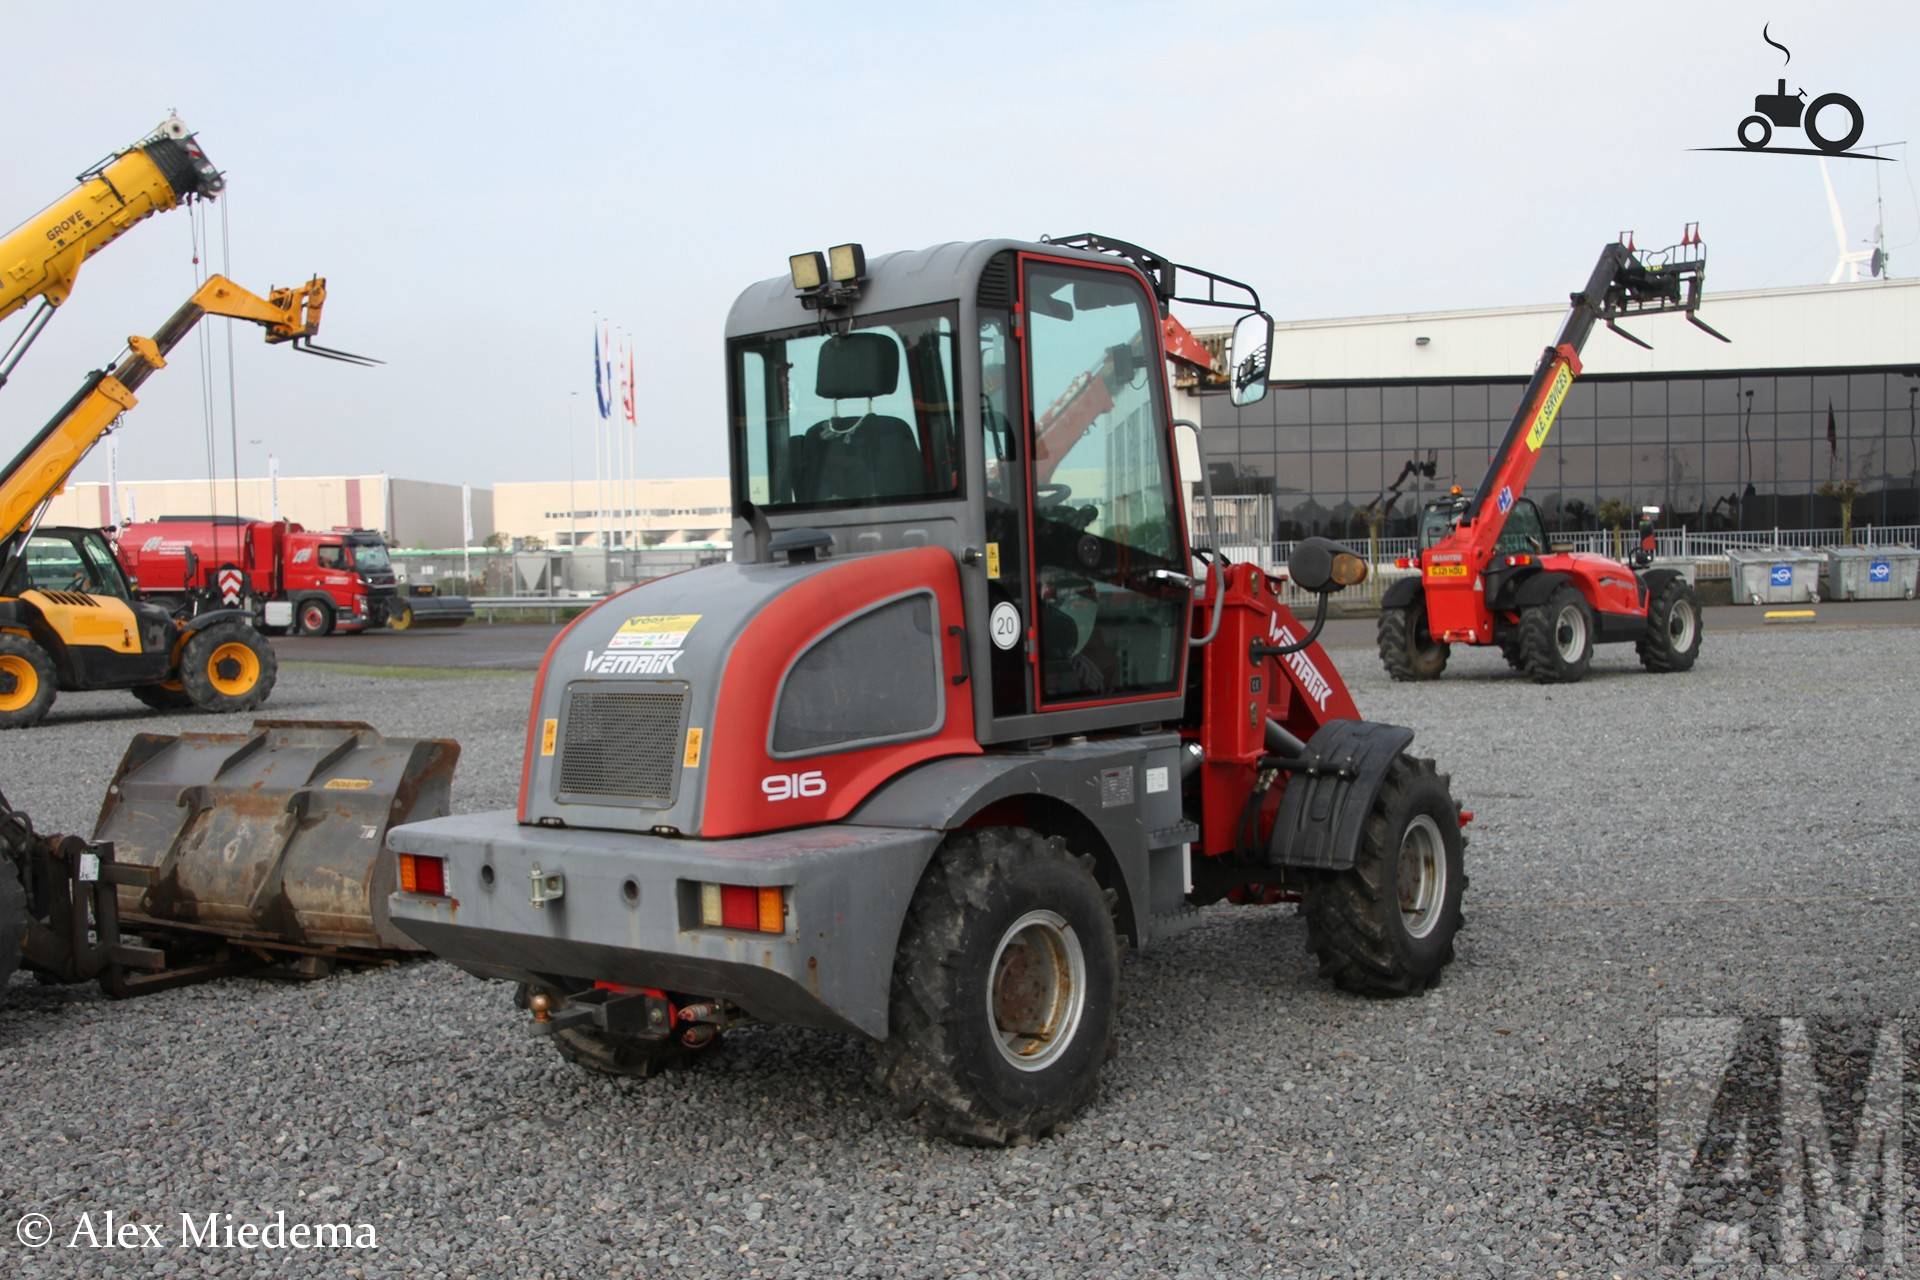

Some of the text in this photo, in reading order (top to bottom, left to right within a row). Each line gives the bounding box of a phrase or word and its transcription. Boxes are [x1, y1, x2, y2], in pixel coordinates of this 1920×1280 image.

[46, 210, 85, 241] GROVE
[1544, 368, 1568, 420] SERVICES
[997, 616, 1014, 635] 20
[761, 770, 827, 801] 916
